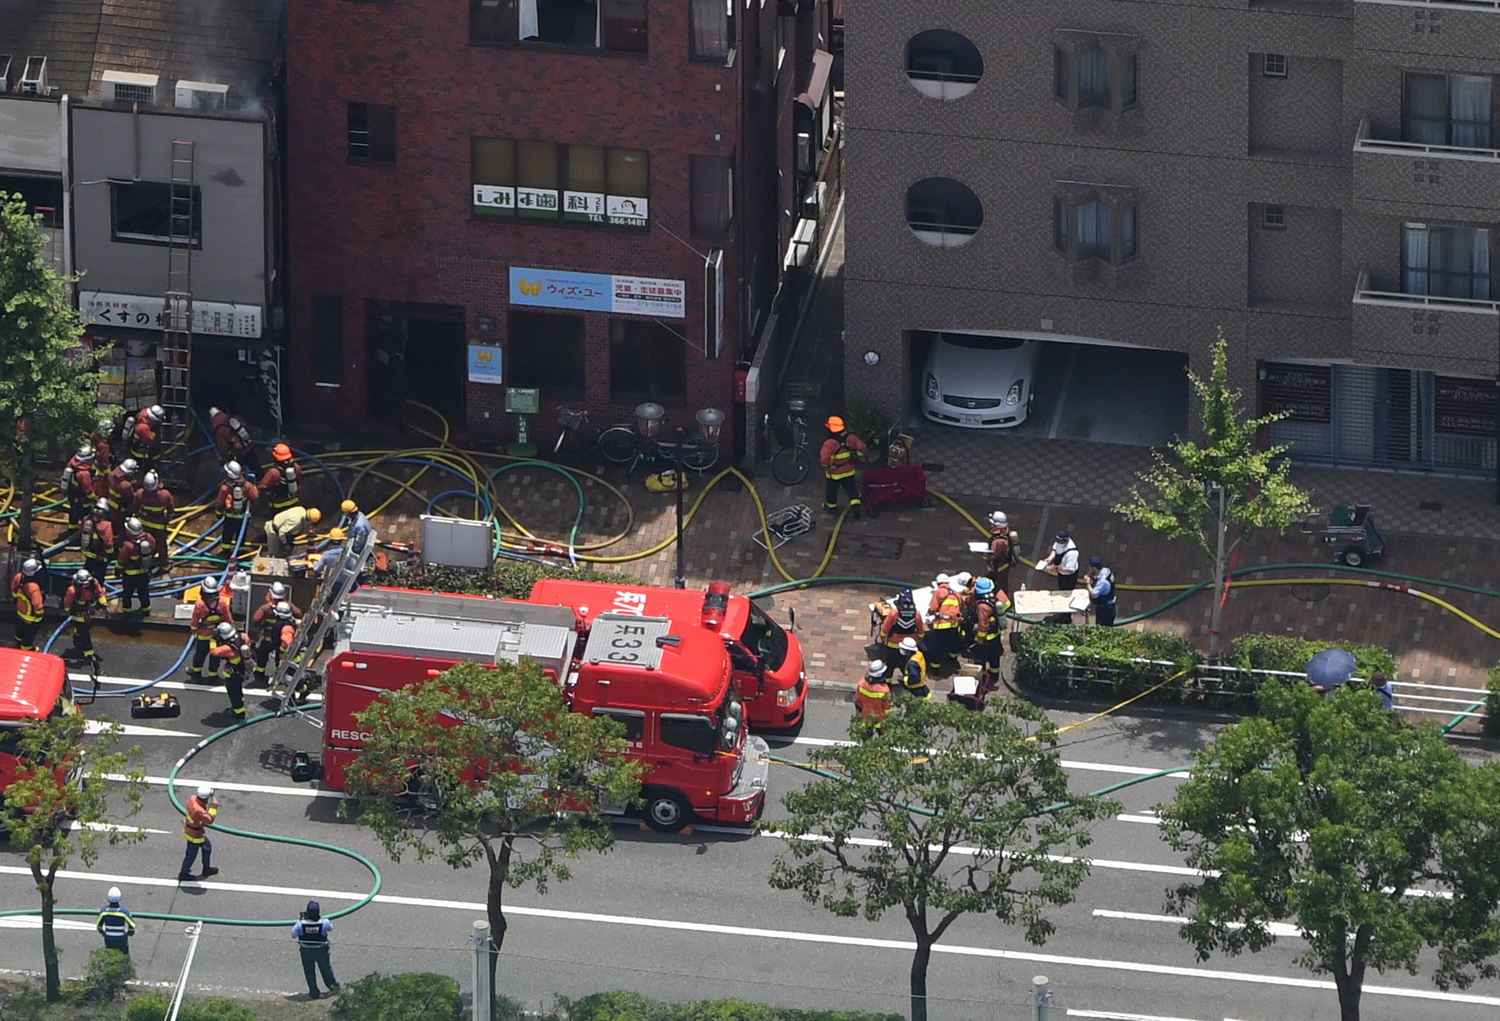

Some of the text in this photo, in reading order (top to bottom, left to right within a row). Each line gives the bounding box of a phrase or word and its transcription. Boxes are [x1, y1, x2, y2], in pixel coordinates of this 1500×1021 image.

[476, 189, 589, 212] しみず歯科
[588, 214, 647, 227] TEL 366-1481
[546, 284, 603, 298] ウィズ・ユー
[607, 624, 646, 662] 兵33
